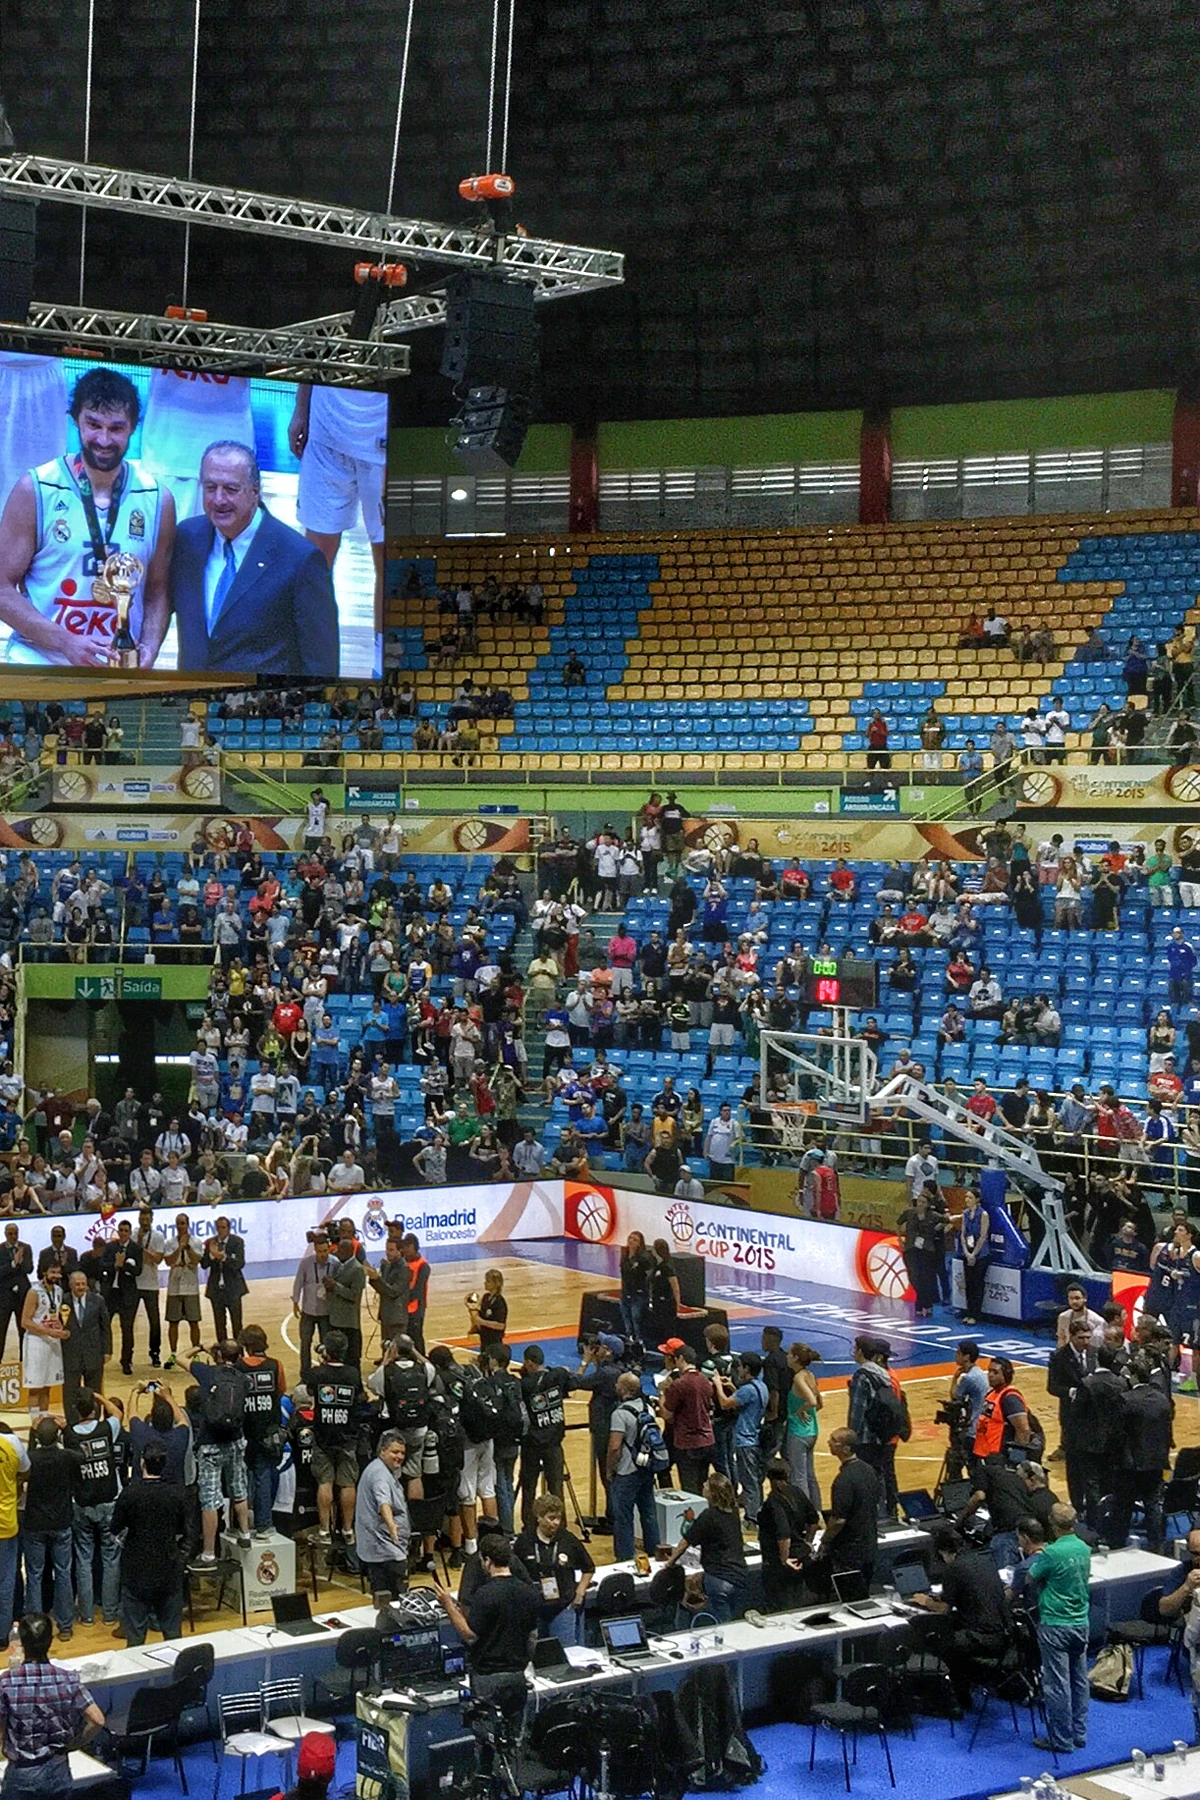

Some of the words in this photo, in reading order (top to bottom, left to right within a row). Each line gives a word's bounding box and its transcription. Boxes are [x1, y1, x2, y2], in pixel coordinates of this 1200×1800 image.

[1116, 788, 1144, 799] 2015
[821, 841, 851, 854] 2015
[123, 981, 160, 994] Saída
[394, 1207, 477, 1231] Realmadrid
[664, 1202, 690, 1222] INTER
[425, 1228, 477, 1242] Baloncesto
[695, 1221, 796, 1251] CONTINENTAL
[695, 1238, 730, 1258] CUP
[732, 1242, 776, 1270] 2015
[0, 1364, 19, 1378] 2015
[321, 1408, 333, 1424] PH
[80, 1463, 94, 1480] PH
